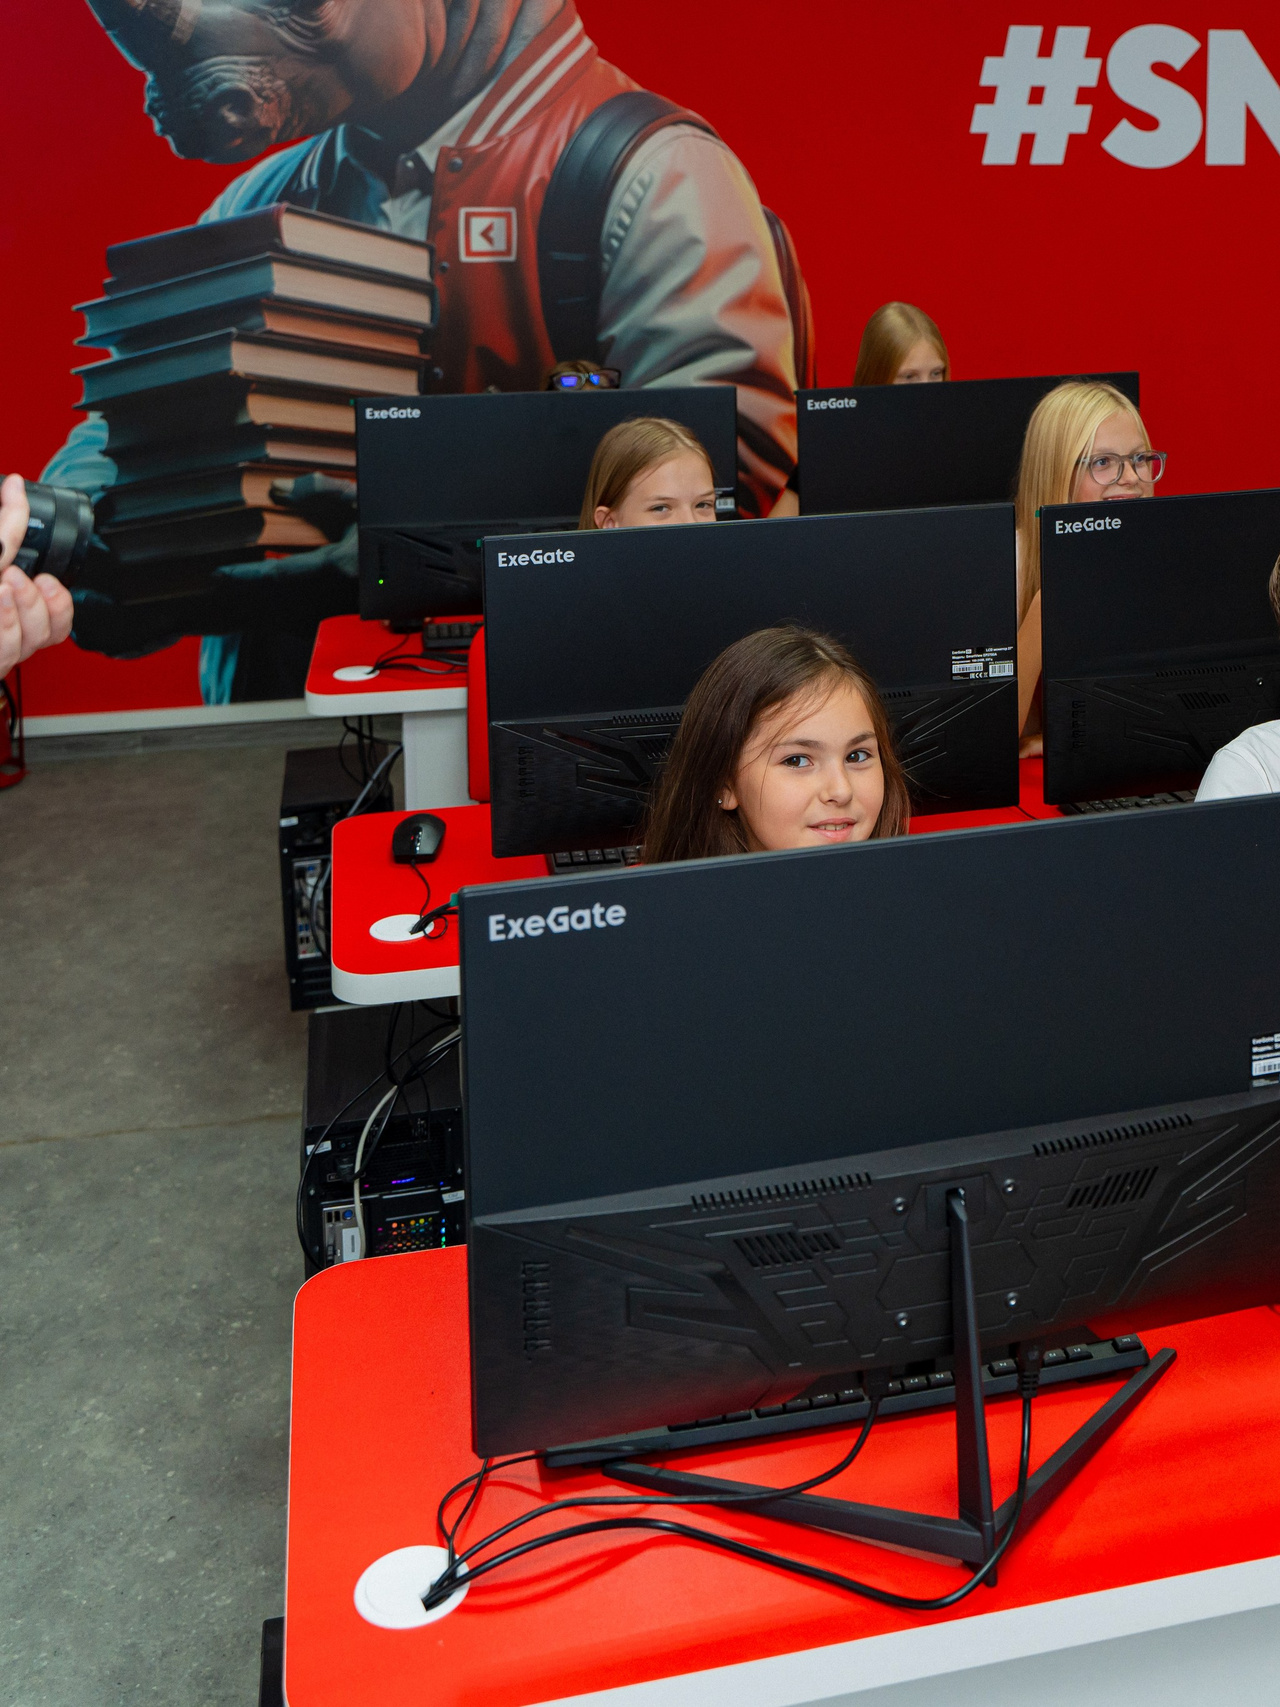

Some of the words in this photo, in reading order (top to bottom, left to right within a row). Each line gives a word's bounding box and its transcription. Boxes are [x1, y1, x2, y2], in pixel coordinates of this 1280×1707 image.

[365, 406, 422, 420] ExeGate
[806, 397, 858, 411] ExeGate
[1055, 516, 1122, 535] ExeGate
[497, 548, 576, 568] ExeGate
[488, 903, 627, 942] ExeGate
